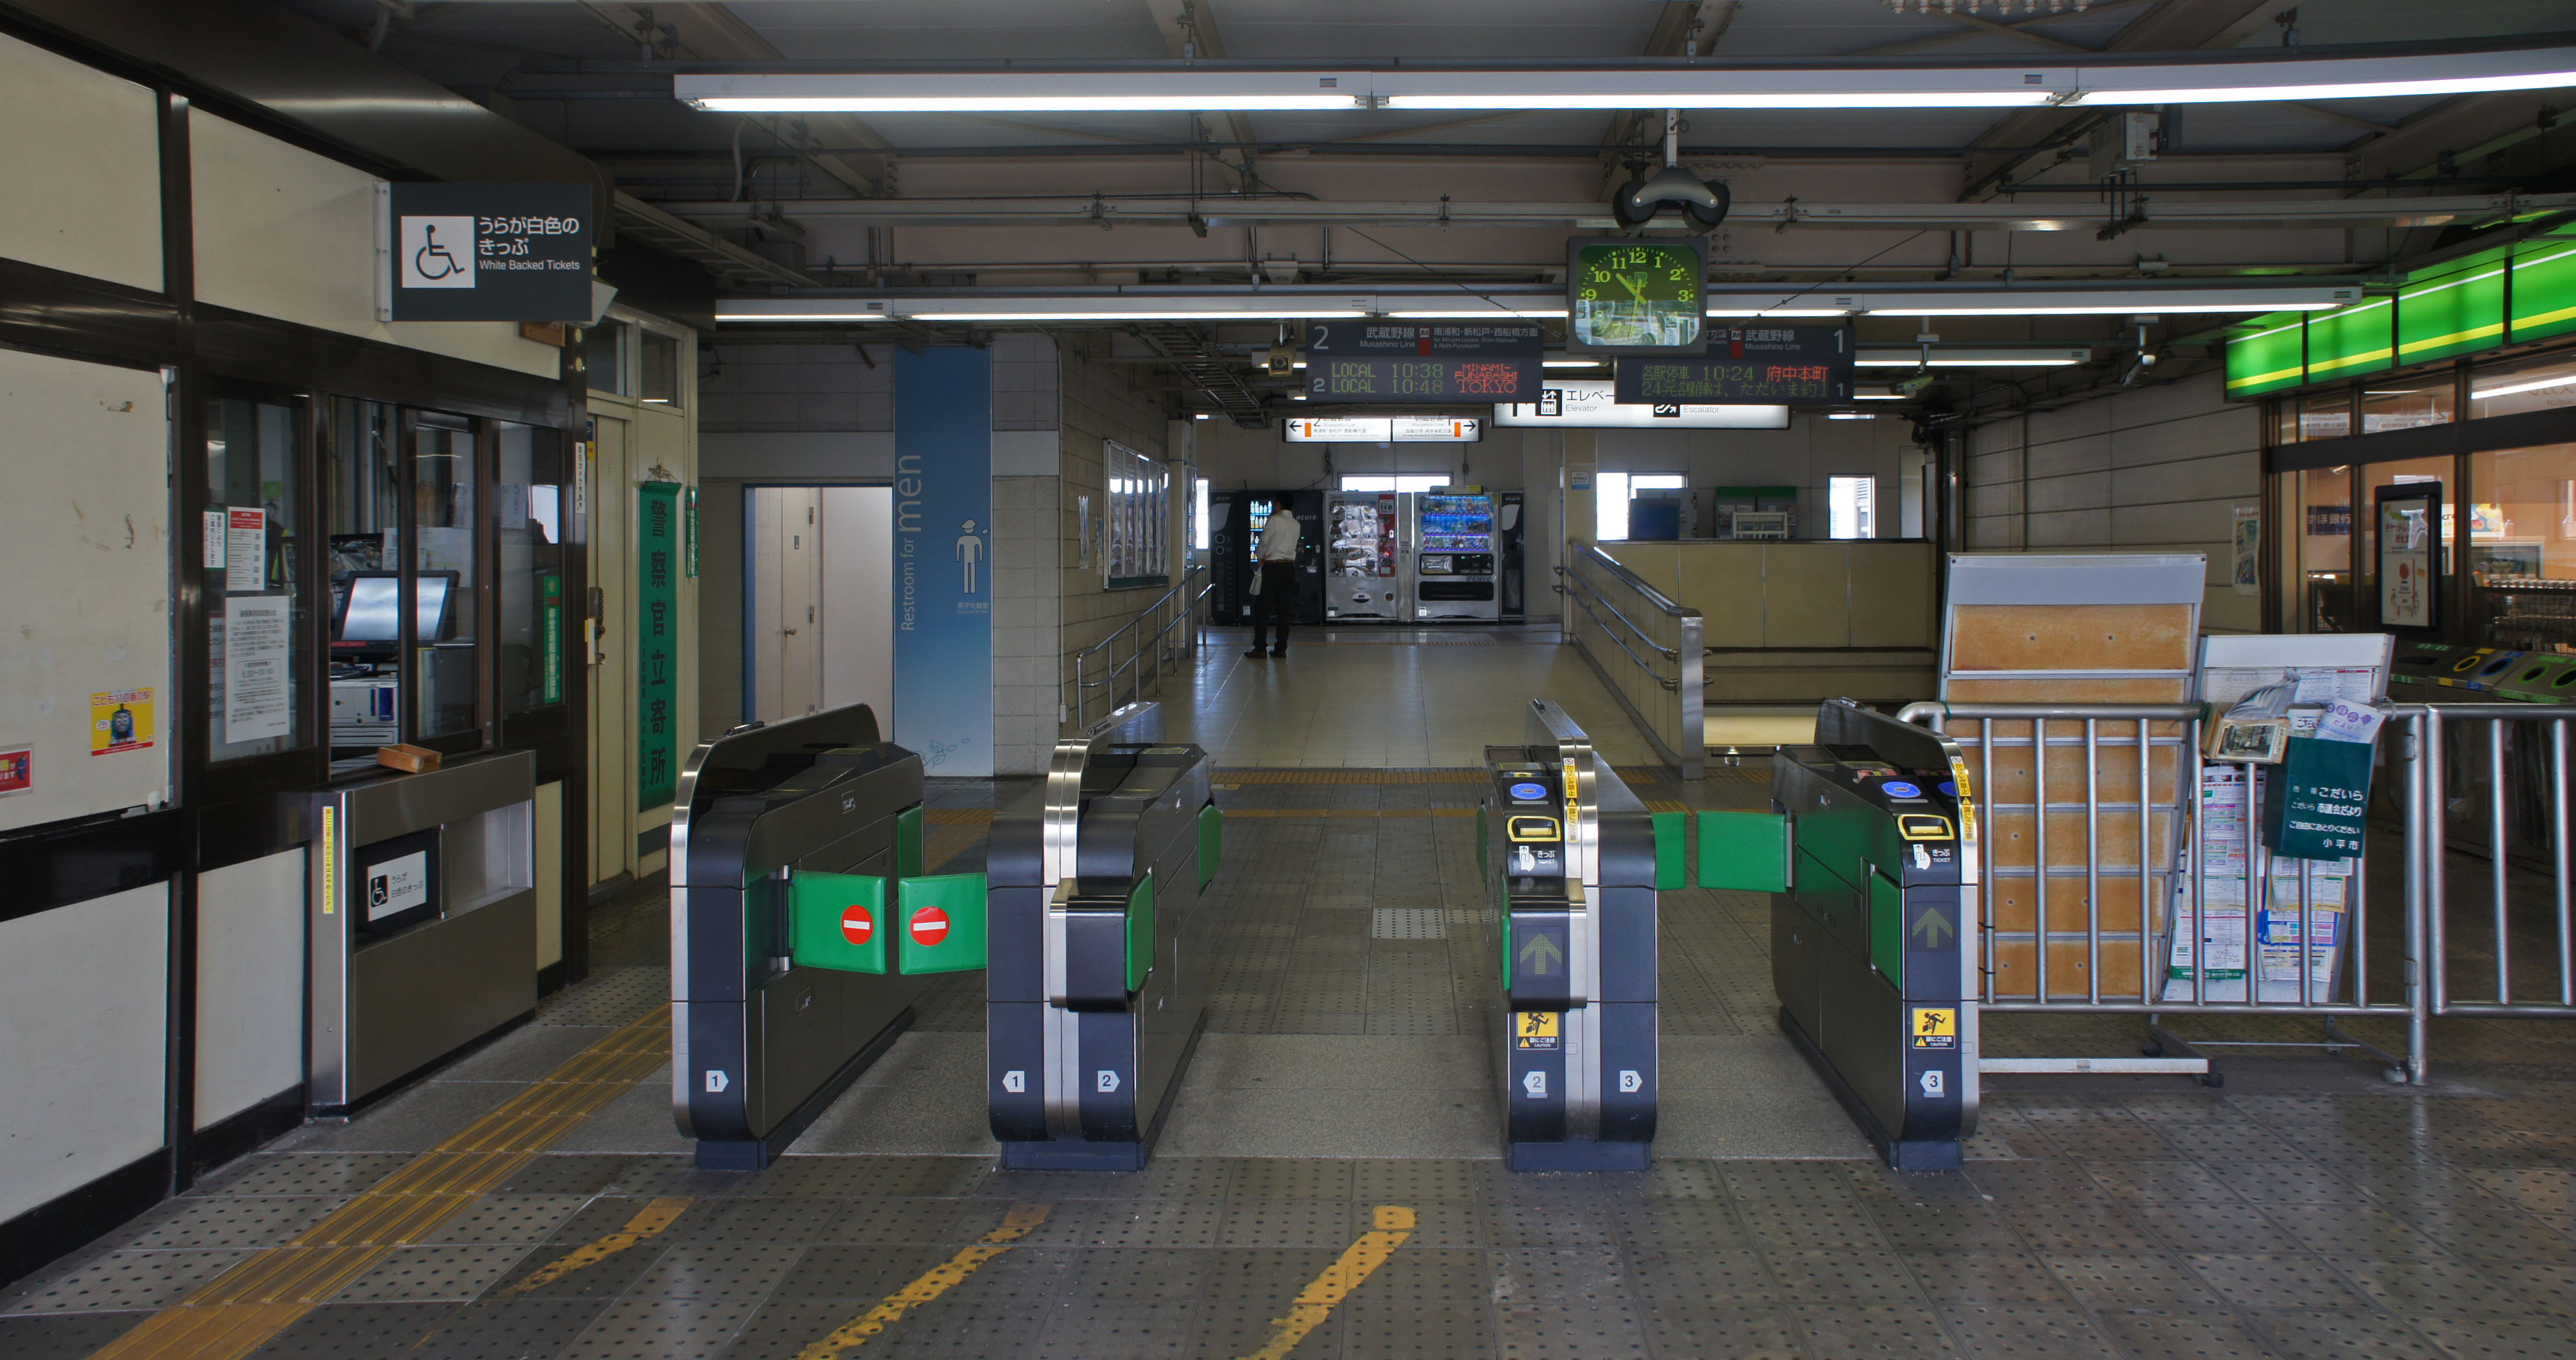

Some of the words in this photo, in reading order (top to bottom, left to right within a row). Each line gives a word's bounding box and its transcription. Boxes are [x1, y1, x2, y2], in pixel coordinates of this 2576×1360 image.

[479, 216, 580, 235] うらが白色の
[479, 238, 529, 256] きっぷ
[1612, 257, 1627, 269] 11
[1629, 251, 1647, 263] 12
[1654, 256, 1662, 268] 1
[479, 260, 506, 270] White
[509, 260, 544, 270] Backed
[547, 260, 580, 270] Tickets
[1594, 271, 1610, 283] 10
[1670, 269, 1682, 281] 2
[1585, 289, 1597, 301] 9
[1678, 290, 1689, 302] 3
[1313, 326, 1329, 350] 2
[1366, 326, 1415, 339] 武蔵野線
[1745, 329, 1795, 342] 武蔵野線
[1833, 330, 1843, 353] 1
[1332, 364, 1377, 378] LOCAL
[1392, 364, 1443, 378] 10:38
[1642, 365, 1690, 382] 各駅停車
[1703, 366, 1755, 381] 10:24
[1766, 365, 1829, 382] 府中本町
[1313, 378, 1325, 392] 2
[1331, 379, 1377, 393] LOCAL
[1392, 379, 1444, 394] 10:48
[1457, 379, 1518, 393] TOKYO
[1837, 382, 1844, 397] 1
[1566, 389, 1615, 401] エレベー
[898, 455, 922, 532] men
[900, 538, 914, 558] for
[901, 562, 914, 631] Restroom
[651, 499, 667, 785] 警察官立寄所
[2319, 787, 2363, 801] こだいら
[2317, 802, 2362, 817] 市議会だより
[2289, 820, 2360, 834] ご自由におとりください
[2323, 838, 2359, 850] 小平市
[712, 1074, 719, 1088] 1
[1012, 1074, 1019, 1088] 1
[1102, 1075, 1111, 1088] 2
[1532, 1075, 1541, 1088] 2
[1624, 1075, 1633, 1088] 3
[1929, 1075, 1938, 1088] 3
